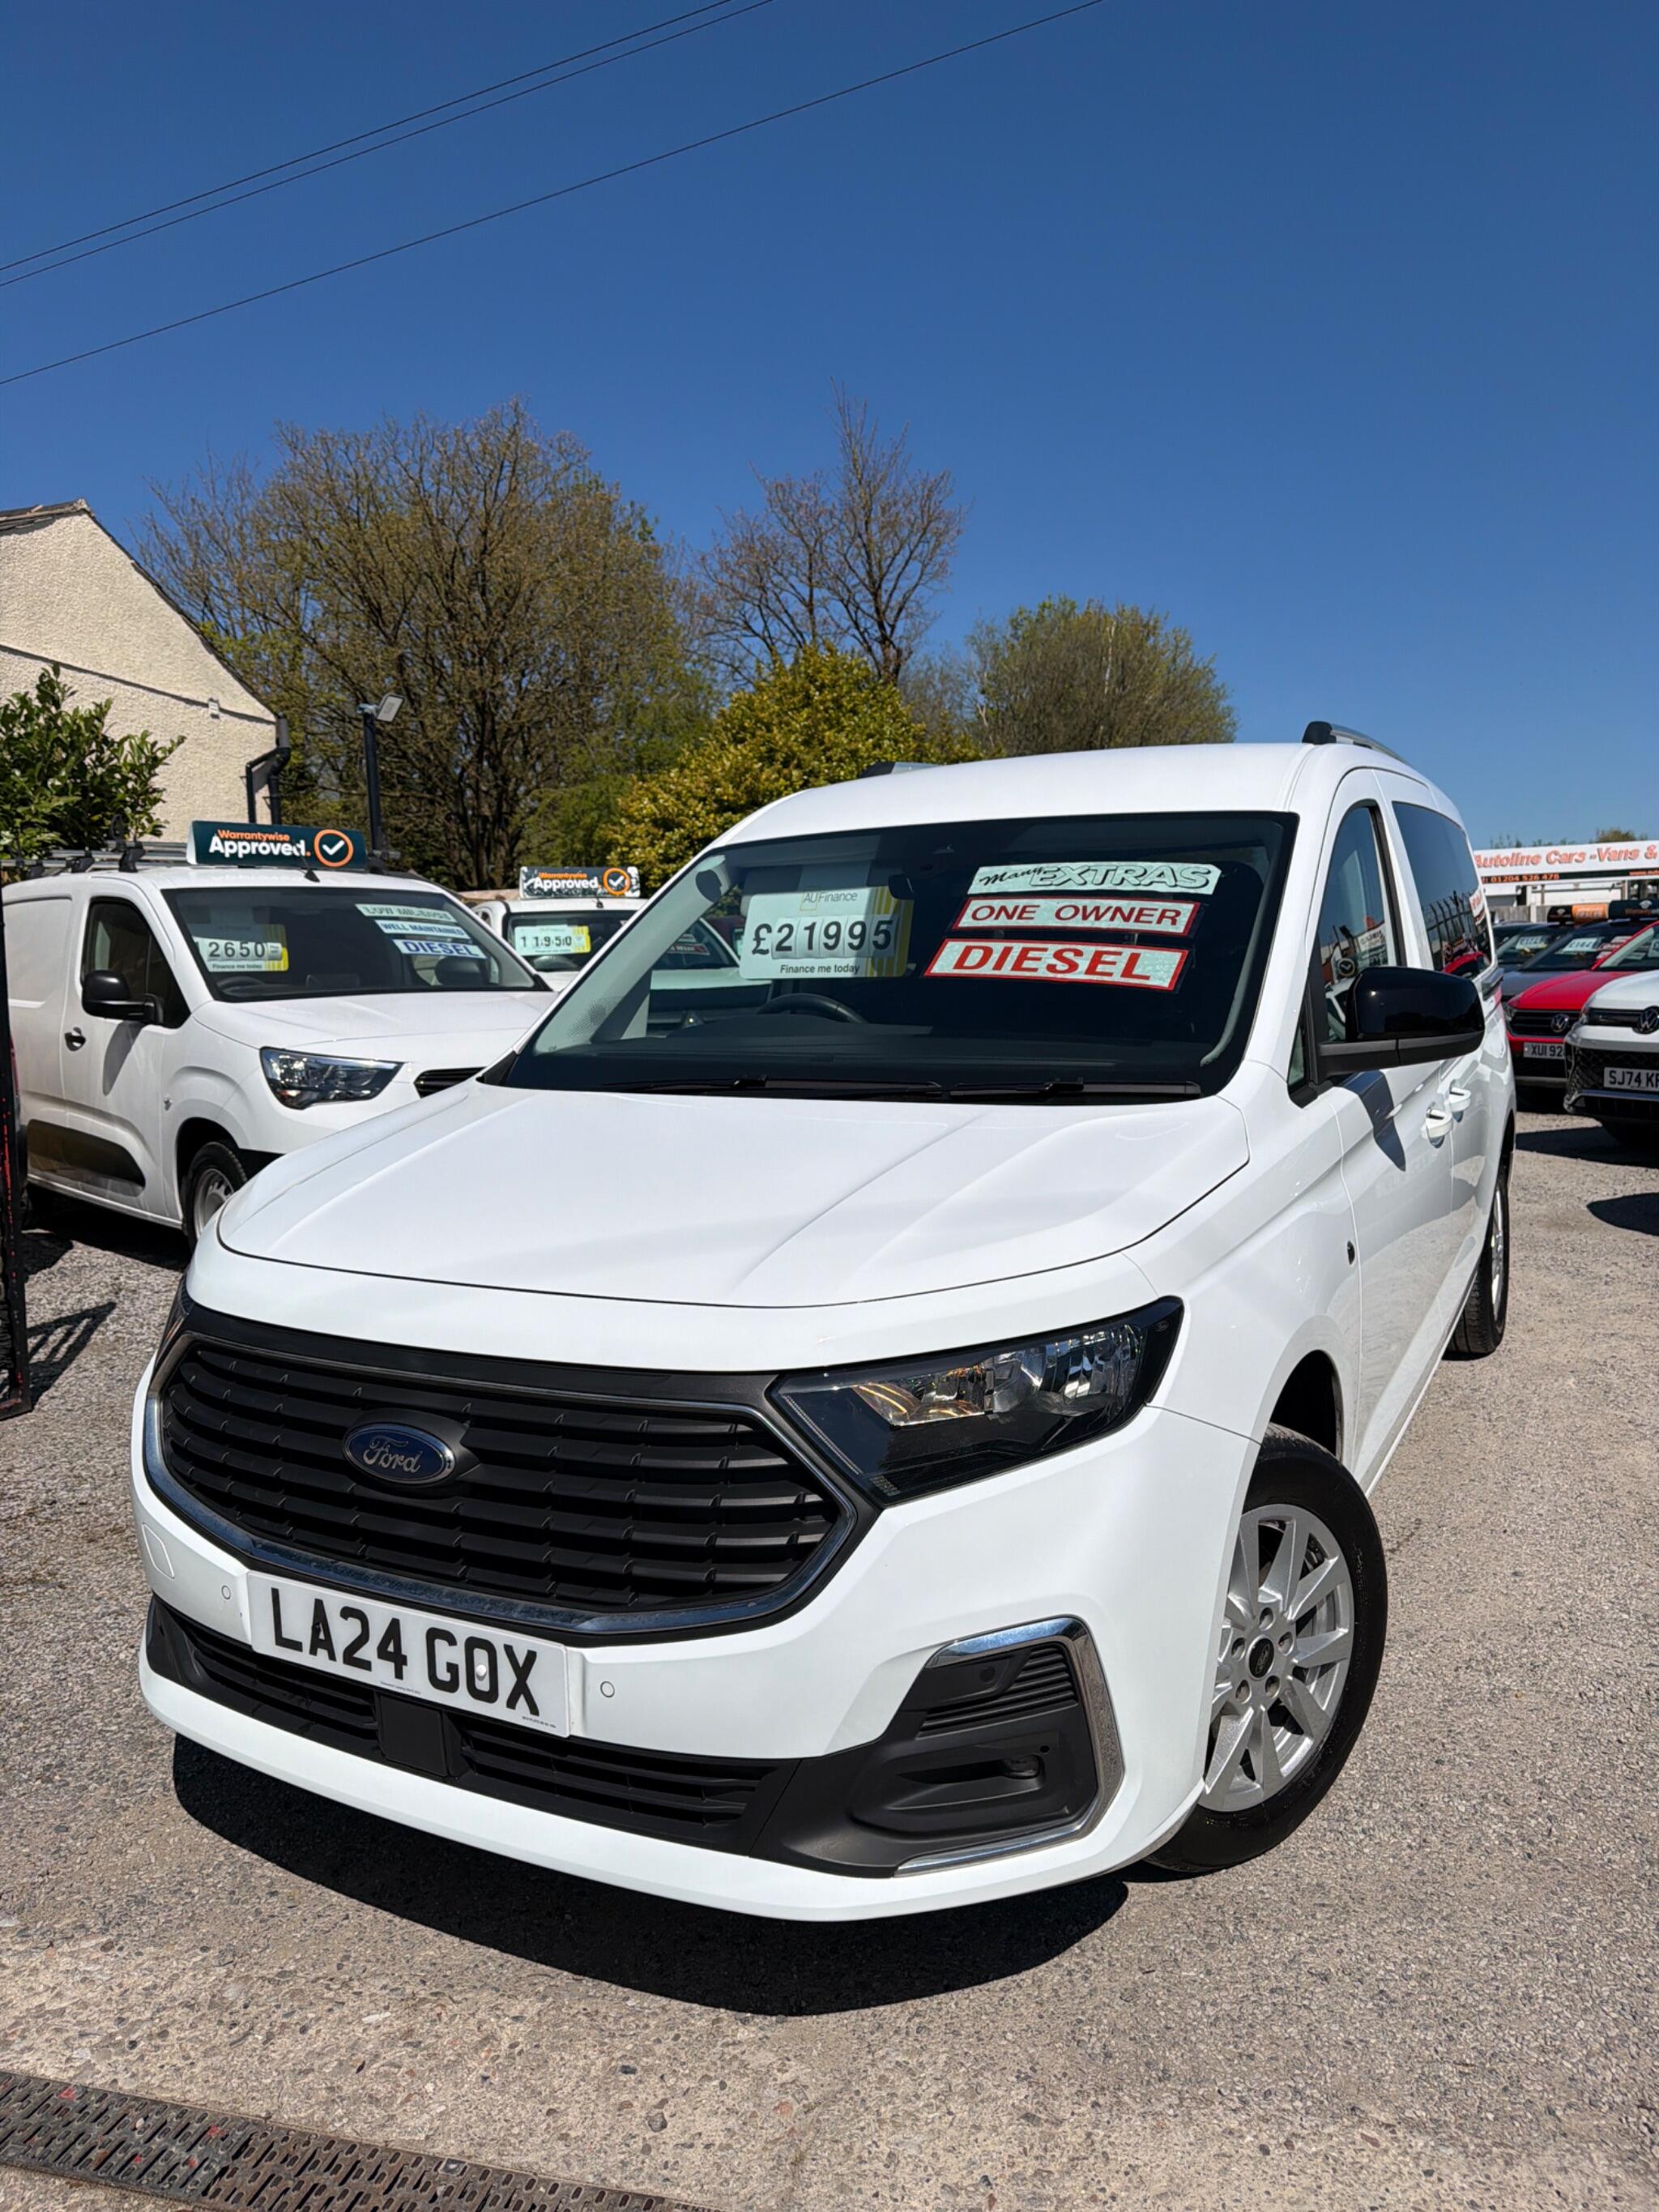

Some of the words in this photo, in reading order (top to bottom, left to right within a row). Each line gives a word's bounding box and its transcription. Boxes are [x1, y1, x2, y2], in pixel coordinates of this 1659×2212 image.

[218, 829, 290, 842] Warrantywise
[1546, 849, 1586, 865] Cars
[979, 866, 1044, 886] Many
[1030, 865, 1213, 889] EXTRAS
[971, 905, 1040, 921] ONE
[1055, 905, 1182, 926] OWNER
[382, 923, 409, 931] WELL
[752, 920, 893, 955] £21995
[403, 941, 479, 956] DIESEL
[779, 964, 815, 973] Finance
[834, 963, 859, 975] today
[953, 945, 1151, 980] DIESEL
[1610, 1070, 1642, 1087] SJ74
[362, 1435, 421, 1474] Ford
[271, 1586, 408, 1680] LA24
[425, 1626, 539, 1717] GOX
